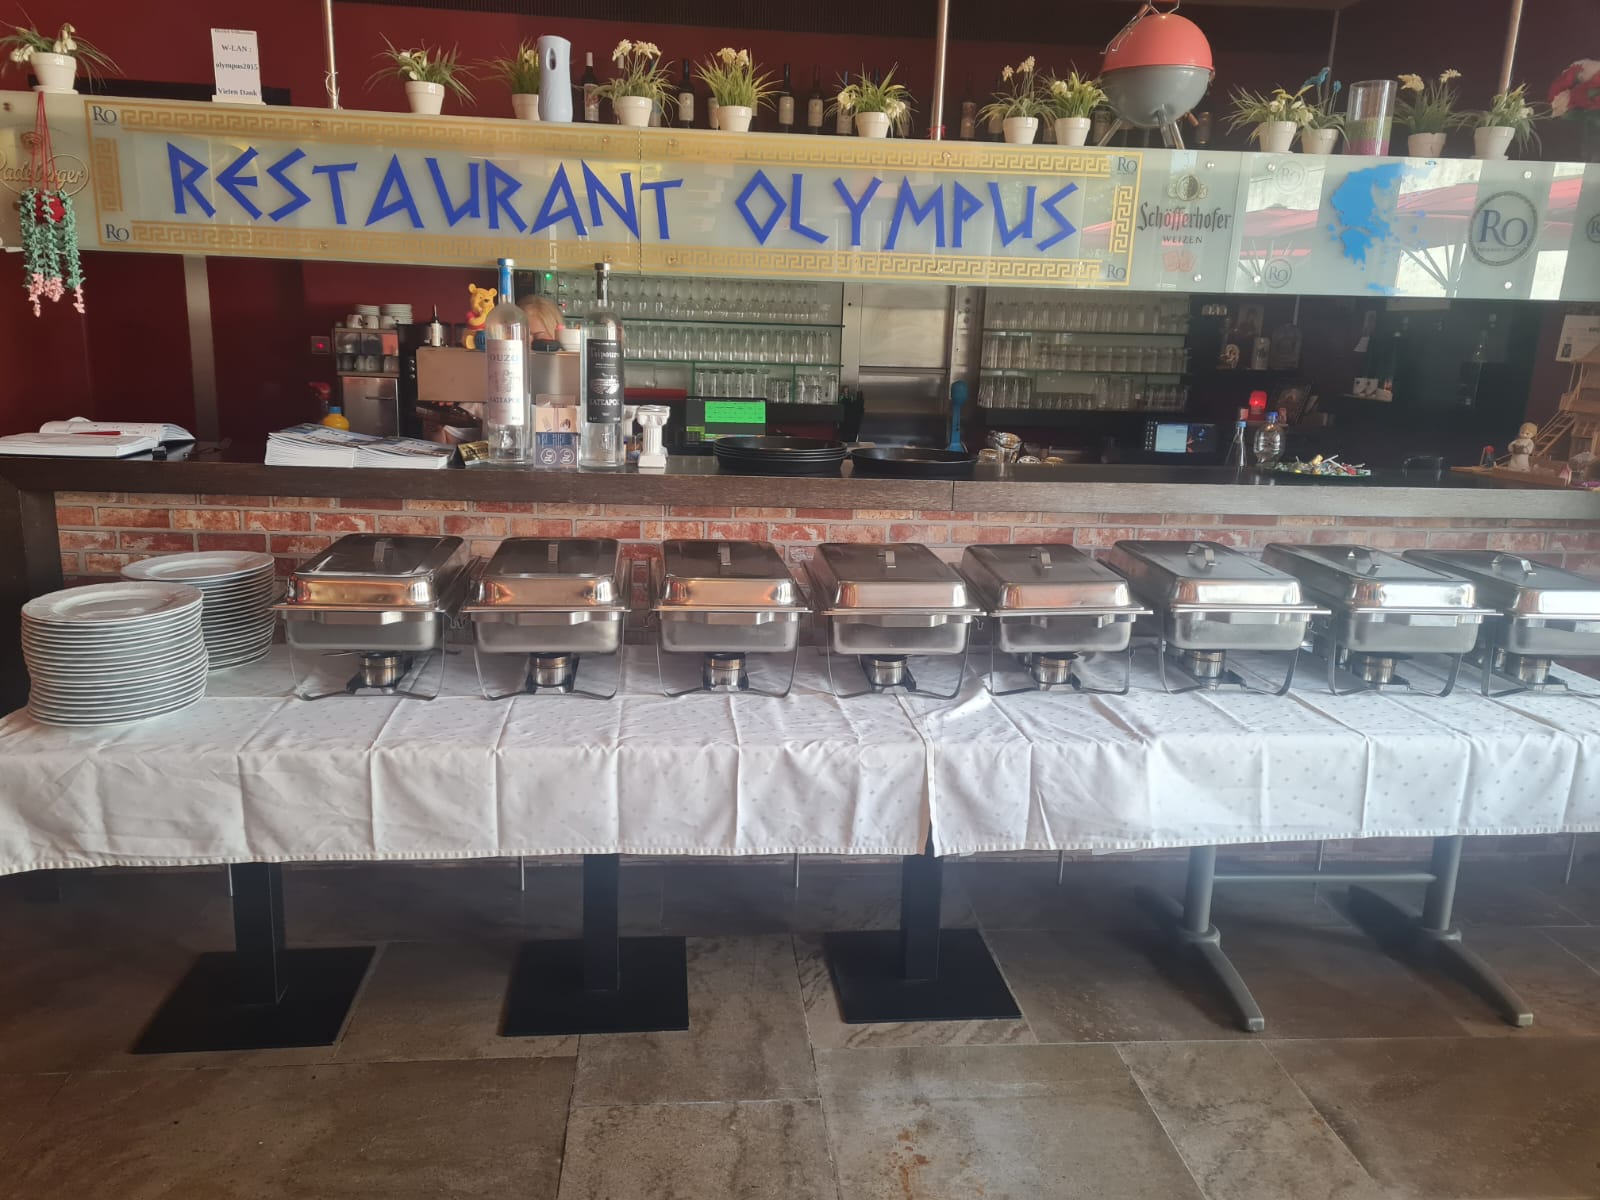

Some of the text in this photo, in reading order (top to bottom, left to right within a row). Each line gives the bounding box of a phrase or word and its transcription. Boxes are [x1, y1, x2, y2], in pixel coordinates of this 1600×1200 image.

[221, 44, 247, 52] W-LAN
[167, 142, 1079, 253] RESTAURANT OLYMPUS
[1137, 202, 1232, 232] Schöfferhofer
[1162, 235, 1203, 245] WEIZEN
